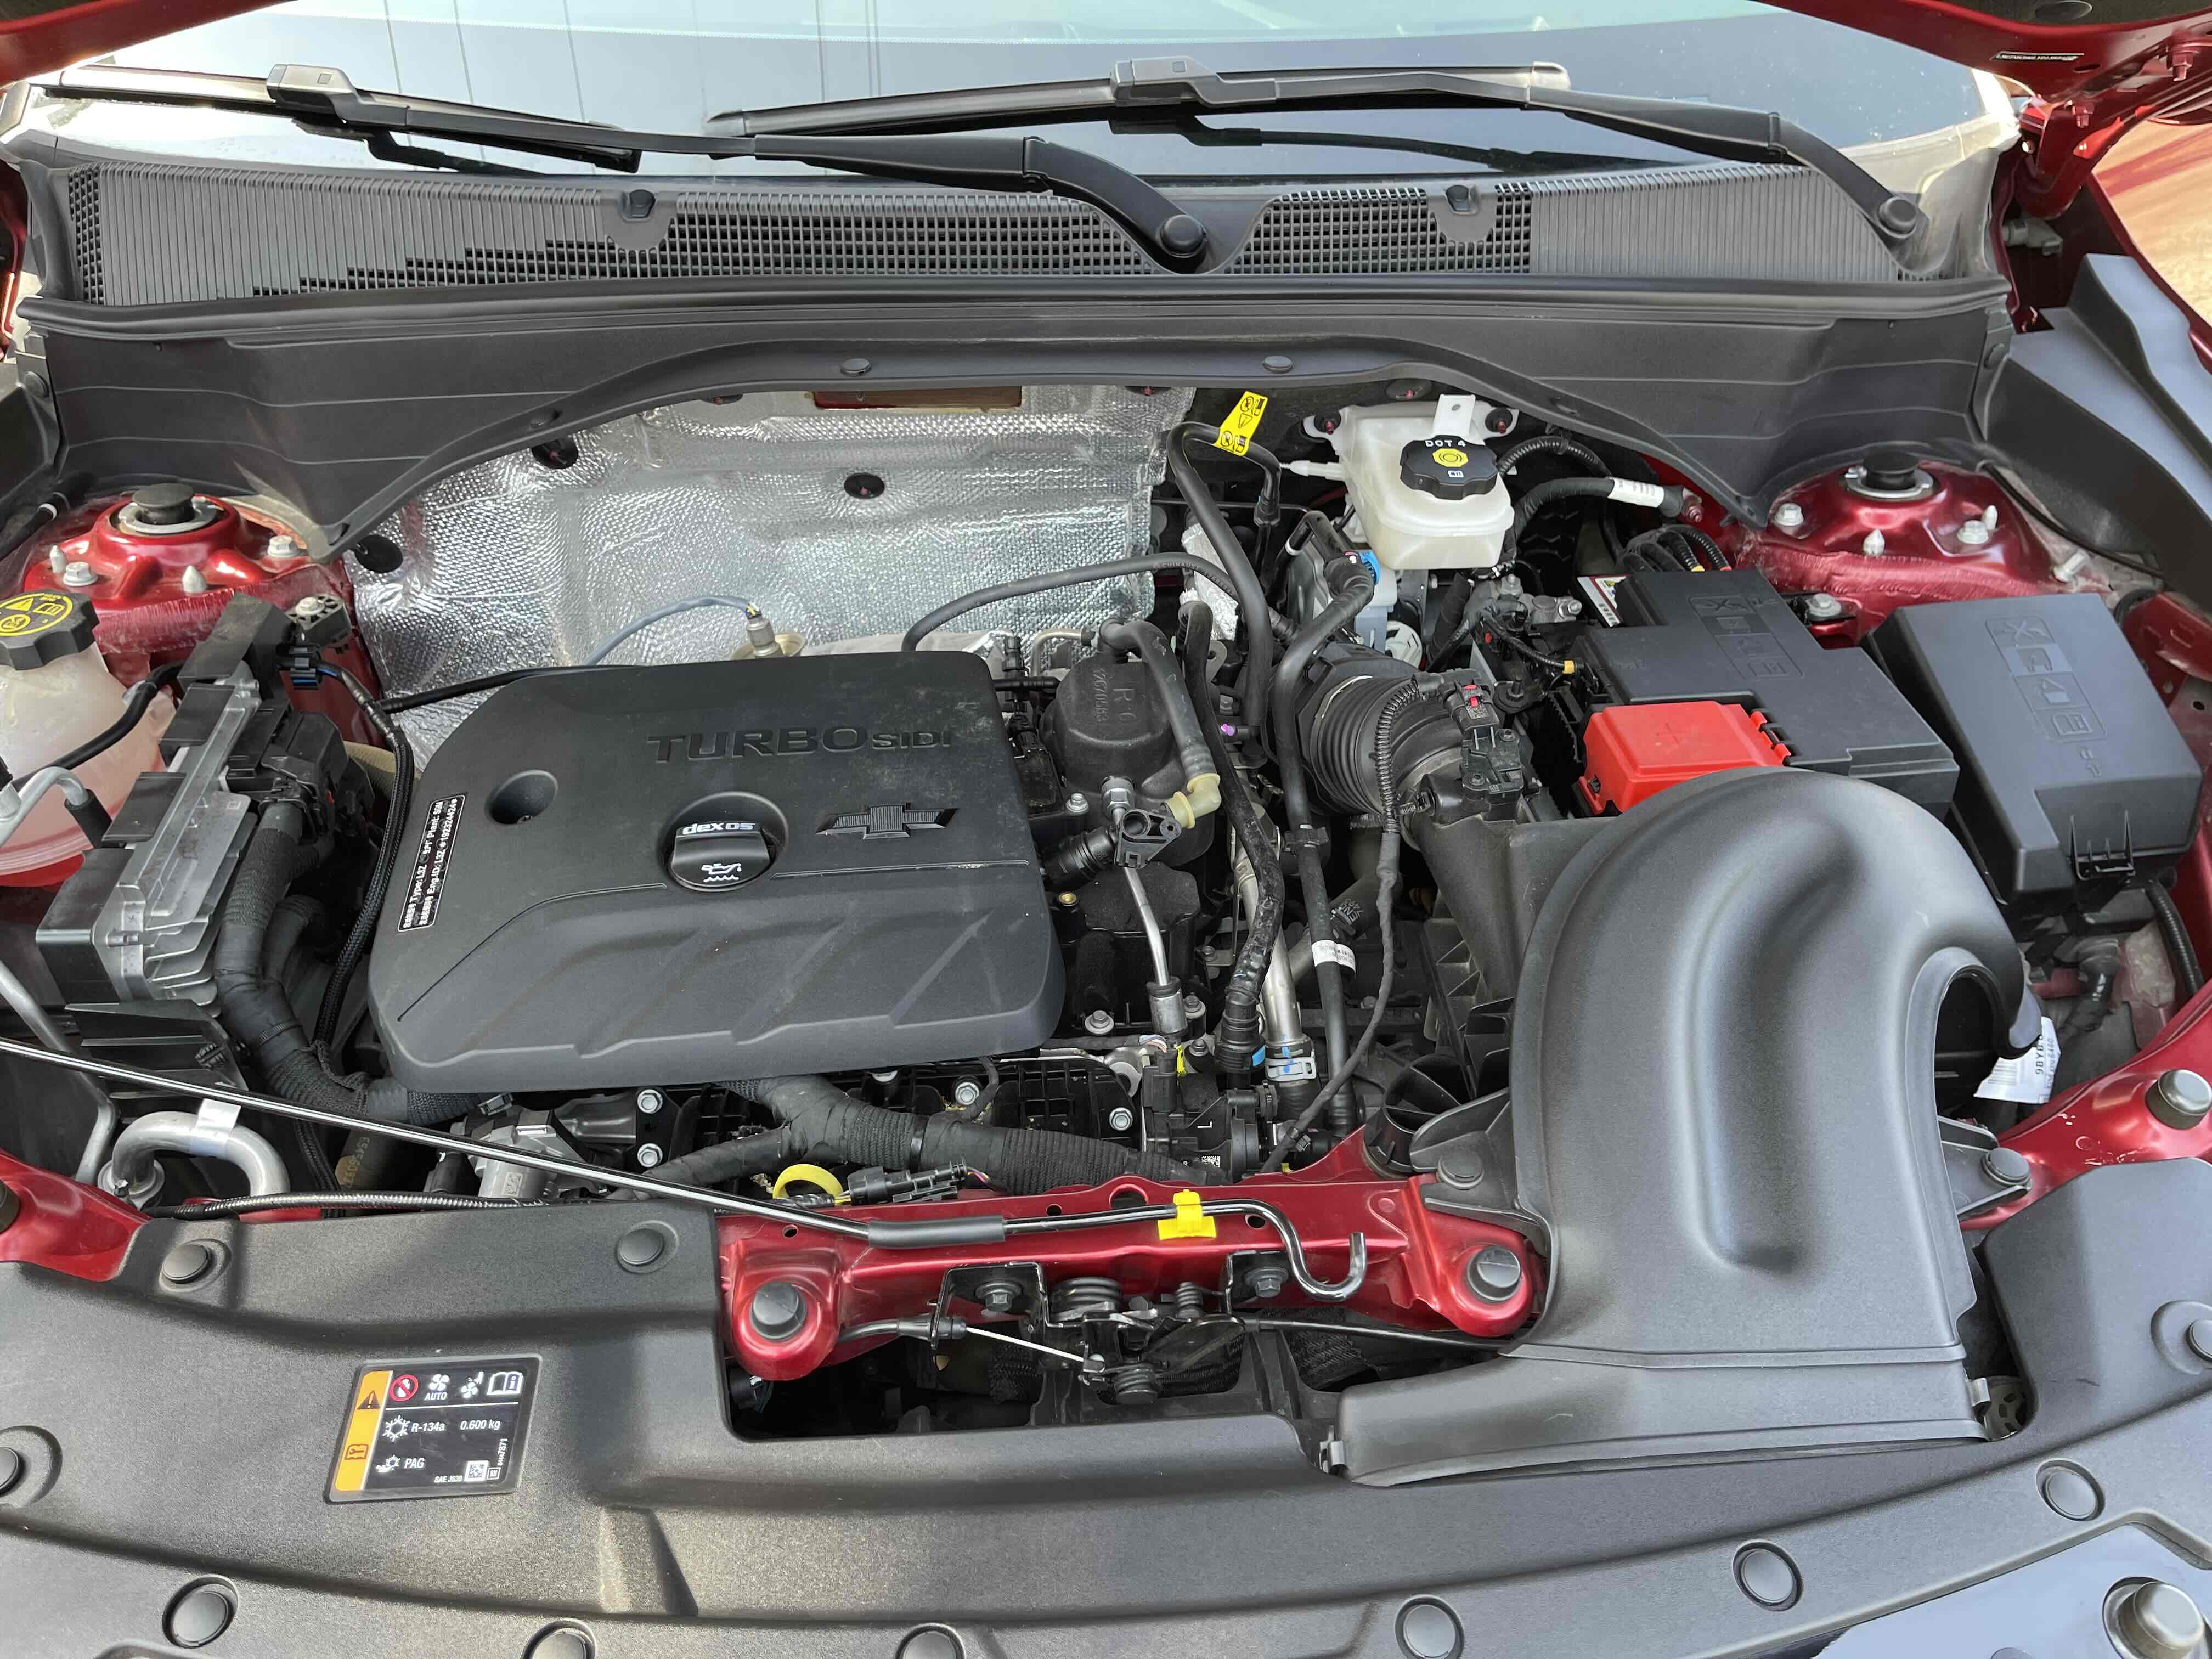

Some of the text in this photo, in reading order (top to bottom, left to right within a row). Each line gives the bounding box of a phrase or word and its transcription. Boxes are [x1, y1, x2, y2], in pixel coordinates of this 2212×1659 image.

[646, 726, 951, 763] TURBO SIDI
[682, 822, 755, 834] dexos
[410, 880, 423, 904] Type:
[427, 816, 439, 840] Plant:
[424, 1392, 447, 1401] AUTO
[411, 1422, 445, 1432] R-134a
[460, 1419, 501, 1431] 0.600 kg
[404, 1458, 426, 1469] PAG
